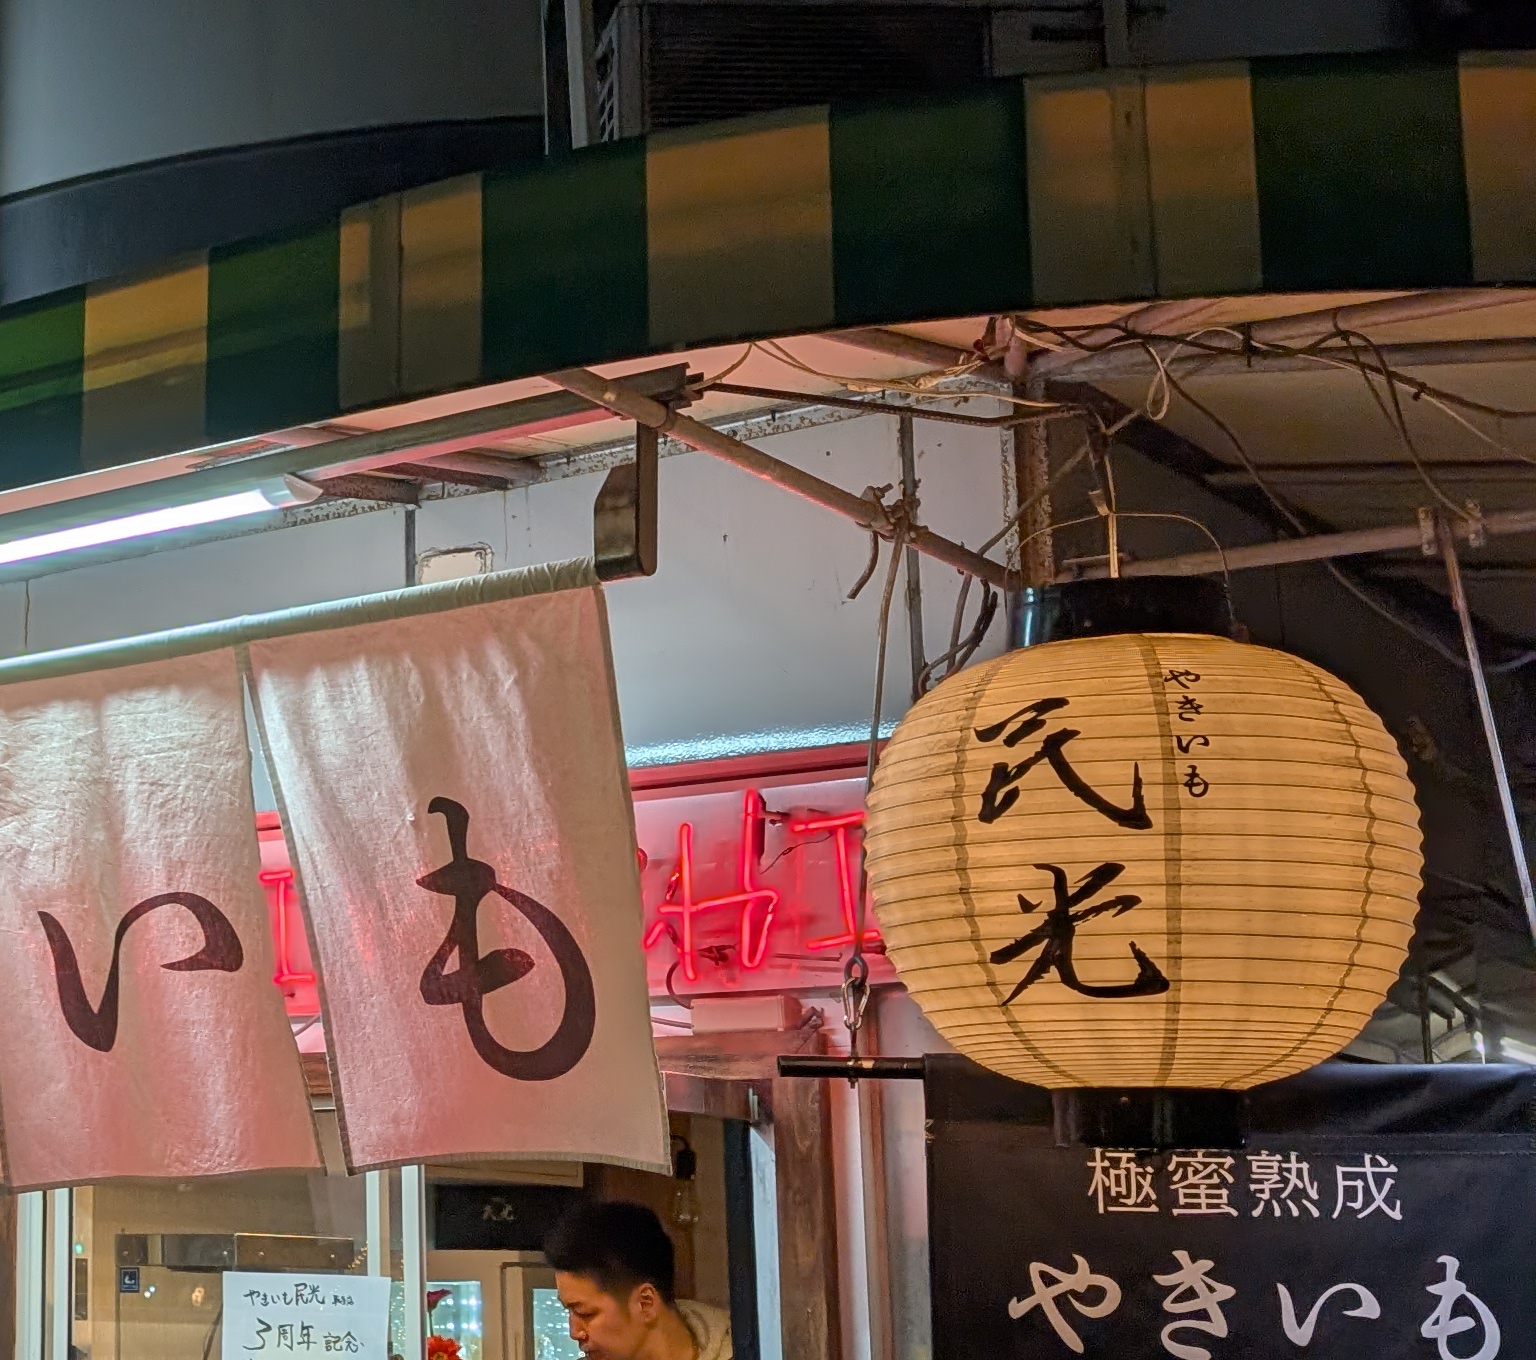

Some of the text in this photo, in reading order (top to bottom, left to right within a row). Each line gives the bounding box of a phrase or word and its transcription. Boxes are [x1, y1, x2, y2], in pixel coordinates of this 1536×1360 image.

[1164, 668, 1210, 800] やきいも
[974, 697, 1170, 1005] 民光
[1086, 1149, 1403, 1222] 極蜜熟成
